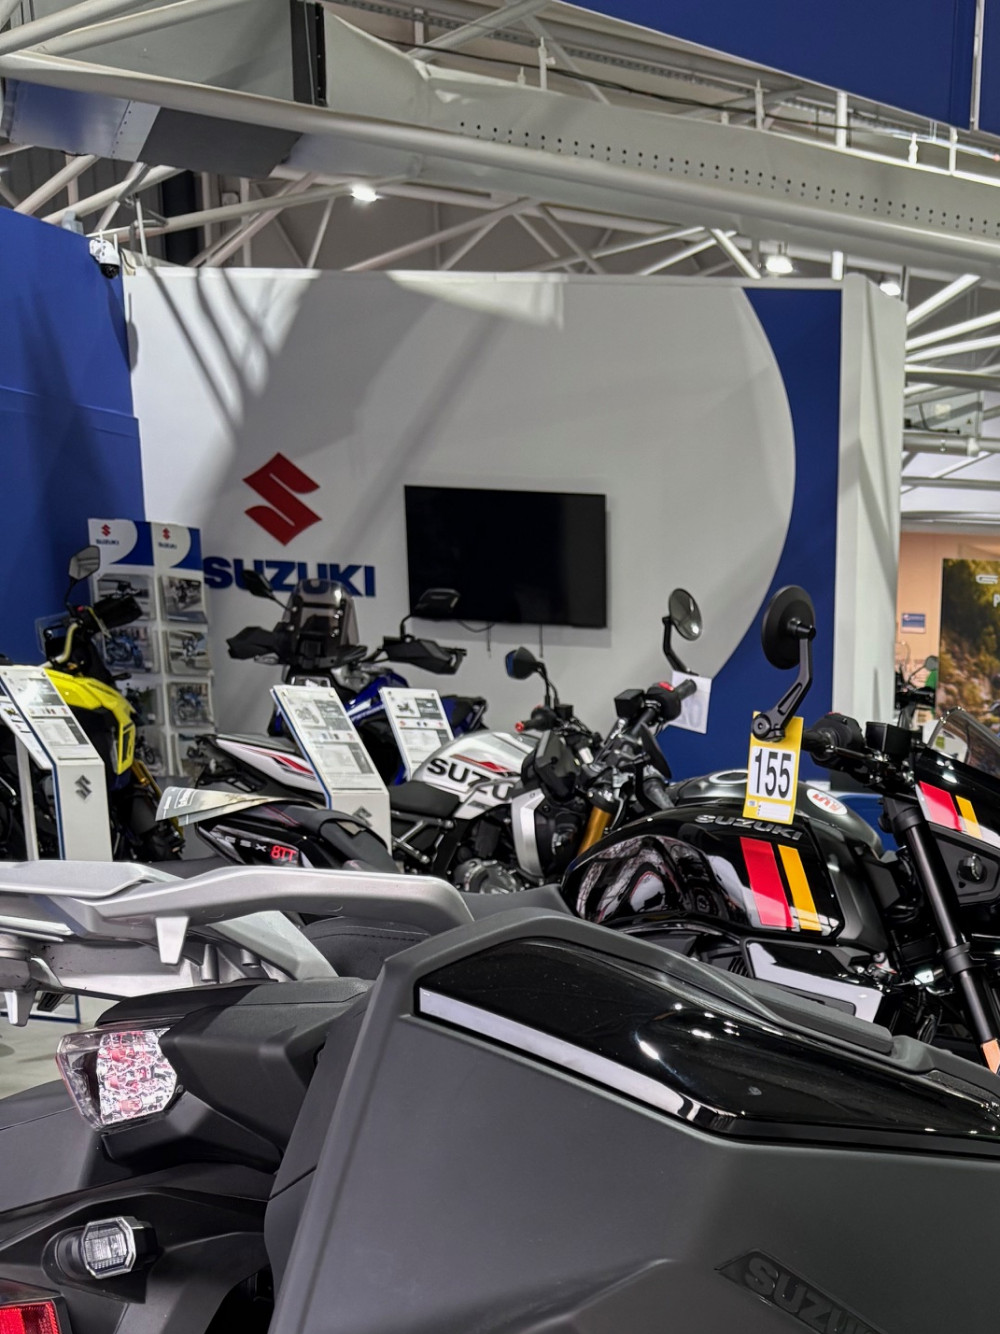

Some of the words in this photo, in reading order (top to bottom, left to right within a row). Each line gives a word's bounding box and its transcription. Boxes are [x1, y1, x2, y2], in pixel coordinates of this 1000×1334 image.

[202, 556, 376, 597] SUZUKI
[427, 757, 513, 802] SUZU
[754, 748, 792, 799] 155
[694, 813, 803, 841] SUZUKI
[271, 845, 297, 862] 8TT
